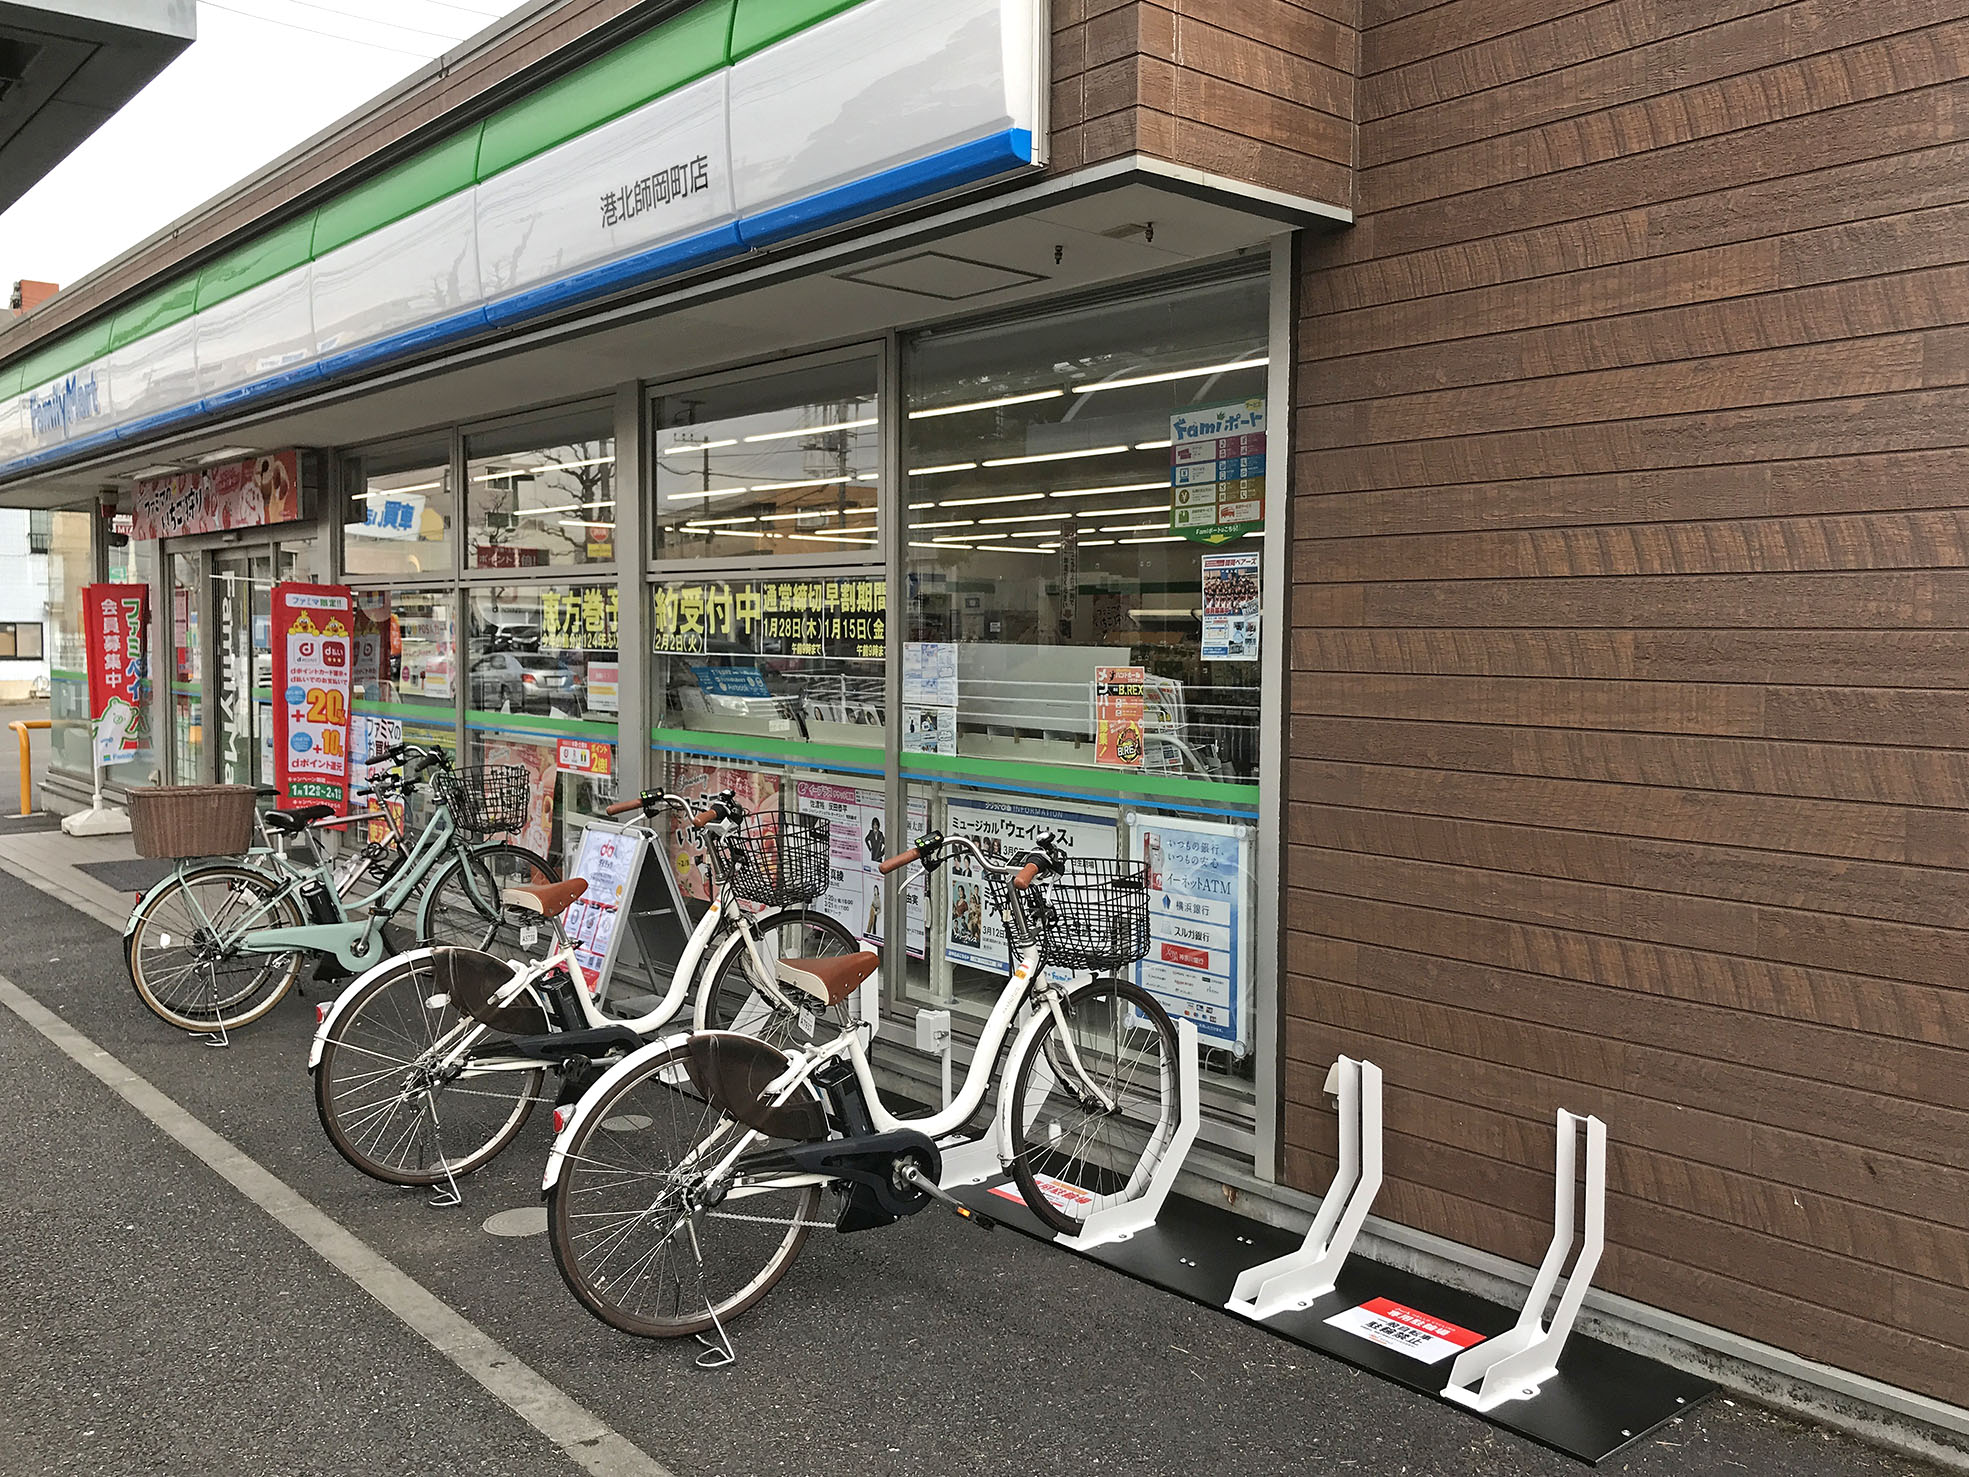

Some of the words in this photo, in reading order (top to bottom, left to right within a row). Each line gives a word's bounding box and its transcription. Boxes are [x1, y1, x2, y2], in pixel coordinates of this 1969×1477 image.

[600, 155, 708, 228] 港北師岡町店
[30, 370, 99, 439] FamilyMart
[655, 584, 761, 634] 約受付中
[763, 583, 822, 612] 通常締切
[101, 598, 122, 688] 会員募集中
[1119, 684, 1144, 696] B.REX
[367, 718, 402, 740] ファミマの
[1167, 854, 1219, 869] いつもの安心
[1166, 873, 1232, 895] イーネットATM
[1176, 899, 1210, 916] 横浜銀行
[1174, 926, 1210, 943] スルガ銀行
[1366, 1321, 1423, 1346] 駐輪禁止
[1377, 1318, 1434, 1341] 一般自転車
